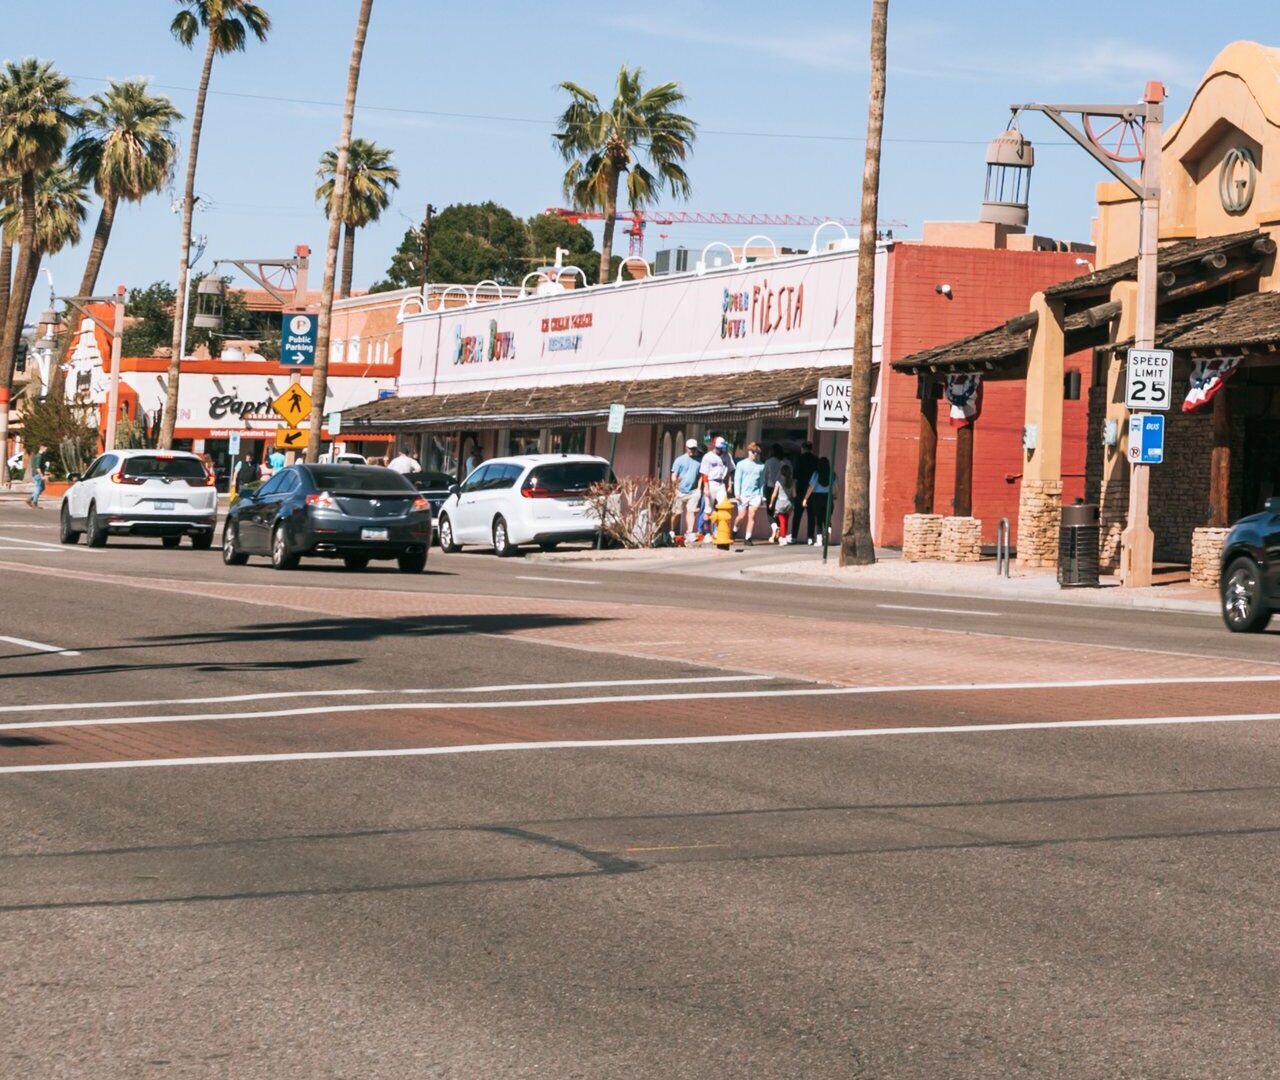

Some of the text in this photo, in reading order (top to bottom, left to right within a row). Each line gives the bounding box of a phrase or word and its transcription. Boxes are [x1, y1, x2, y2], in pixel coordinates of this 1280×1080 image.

[286, 344, 314, 353] Parking
[1132, 356, 1168, 366] SPEED
[1135, 368, 1164, 378] LIMIT
[826, 384, 852, 397] ONE
[1131, 381, 1166, 401] 25
[1145, 423, 1159, 431] BUS
